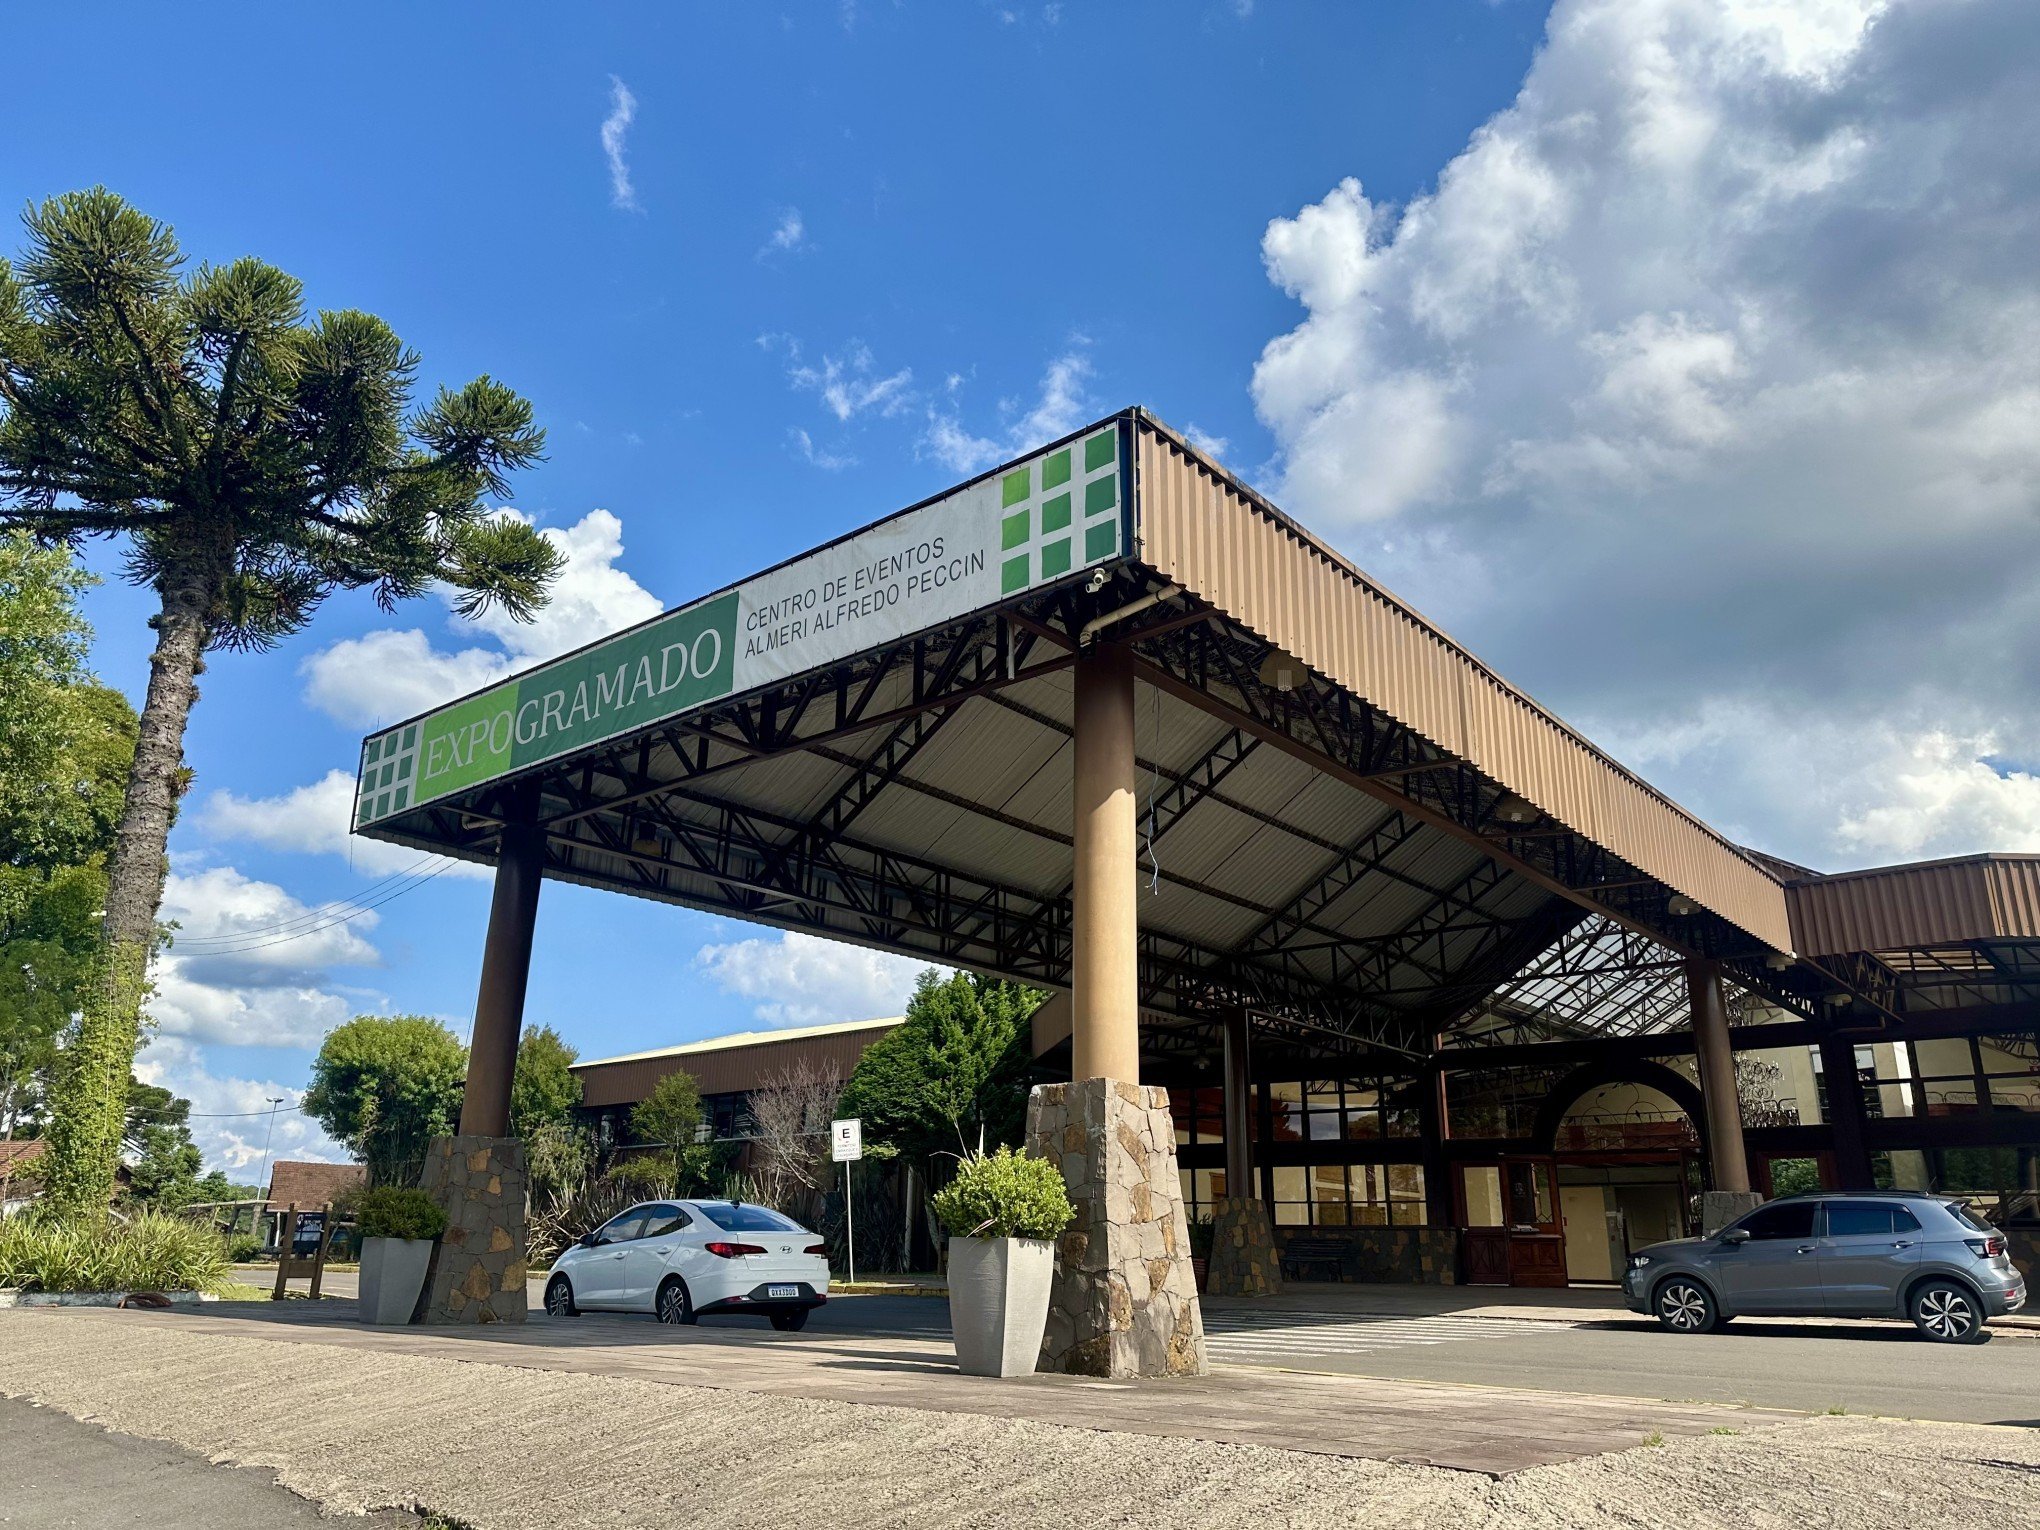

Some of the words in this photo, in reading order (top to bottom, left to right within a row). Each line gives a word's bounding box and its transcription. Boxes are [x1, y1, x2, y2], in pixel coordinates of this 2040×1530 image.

[744, 618, 808, 659] ALMERI
[813, 583, 900, 634] ALFREDO
[907, 549, 984, 598] PECCIN
[746, 588, 817, 631] CENTRO
[823, 576, 847, 603] DE
[854, 537, 944, 591] EVENTOS
[842, 1128, 851, 1139] E
